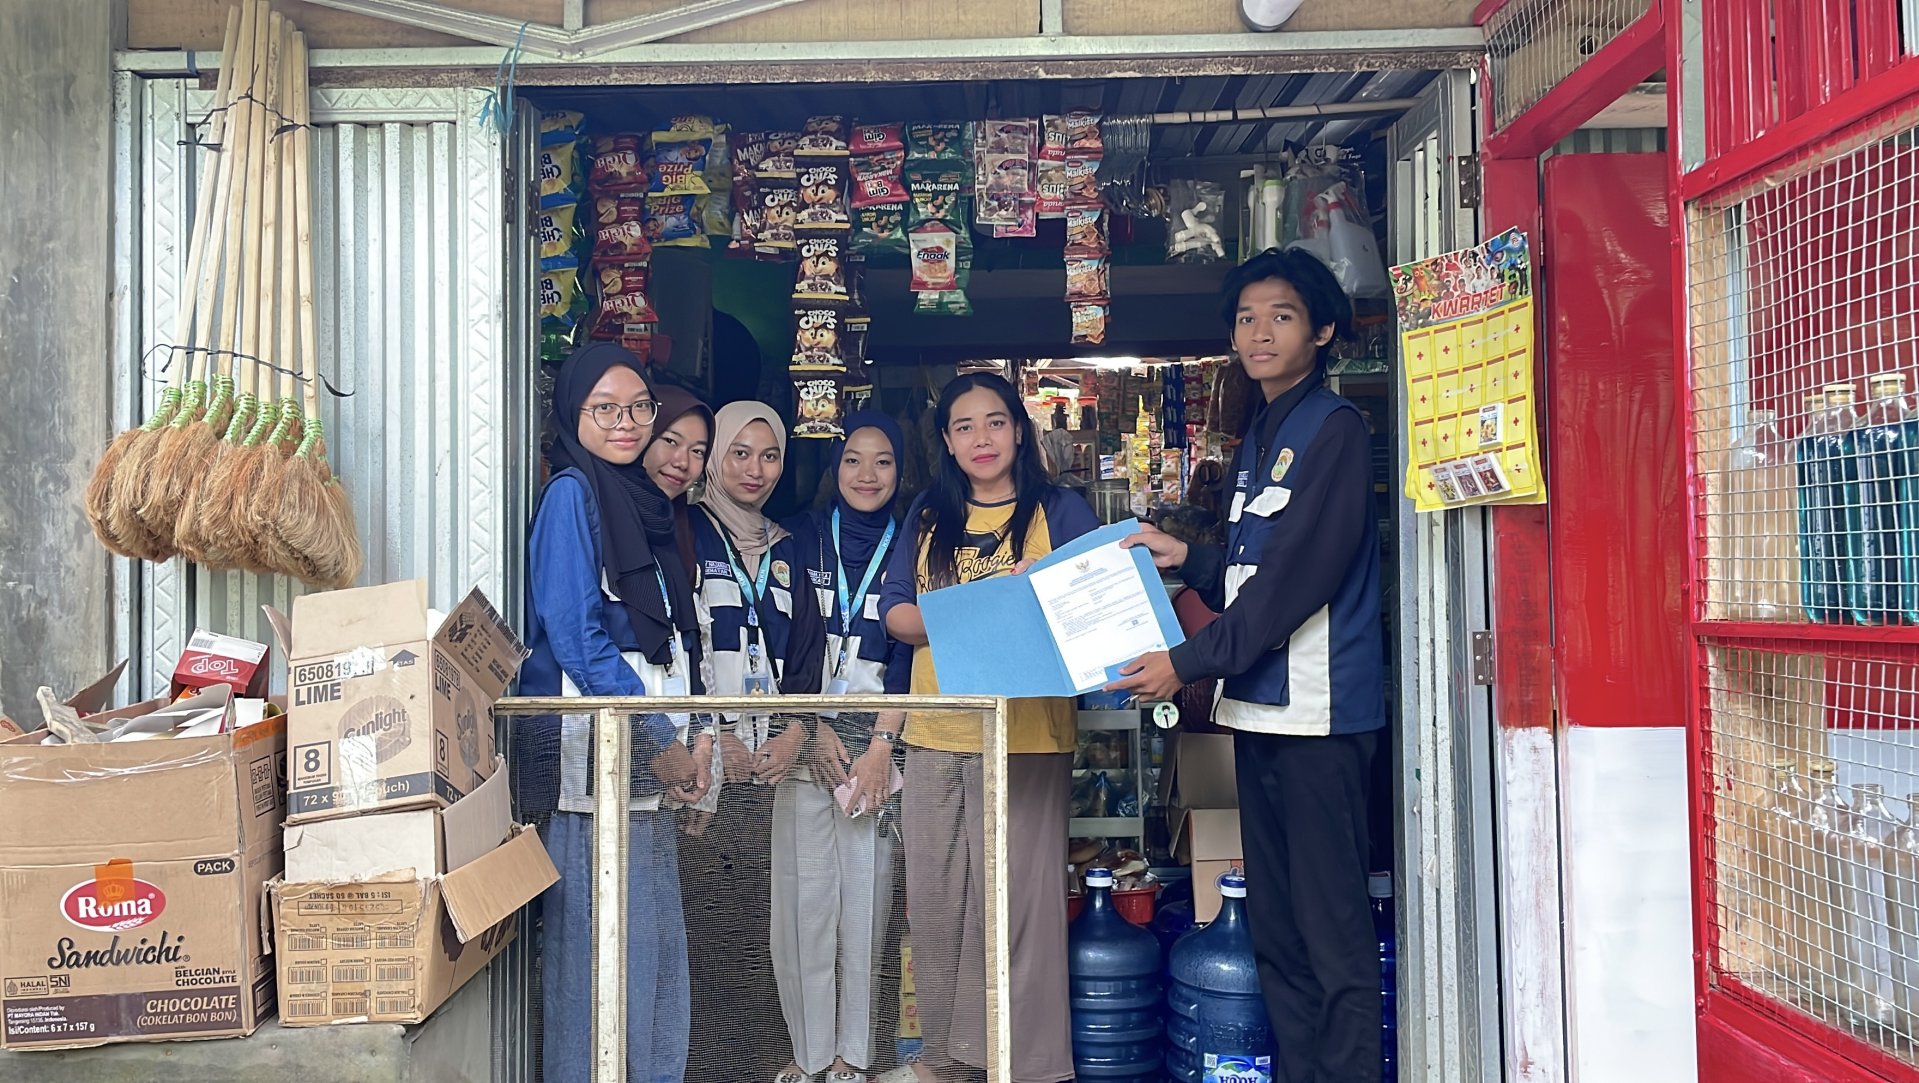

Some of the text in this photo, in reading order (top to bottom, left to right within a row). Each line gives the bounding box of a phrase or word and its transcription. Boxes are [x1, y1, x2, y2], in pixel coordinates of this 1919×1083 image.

[658, 164, 693, 175] Prize
[808, 166, 837, 174] CHOCO
[1066, 166, 1094, 179] Malkist
[800, 172, 839, 187] CHIPS
[868, 187, 889, 197] Gim
[911, 182, 960, 192] MAKARENA
[650, 204, 684, 216] Prize
[1067, 215, 1094, 228] Malkist
[598, 220, 642, 244] Qtela
[801, 244, 839, 258] CHIPS
[916, 250, 951, 260] Enaak
[602, 292, 648, 314] Qtela
[1432, 283, 1506, 320] KWARTET
[798, 315, 838, 330] CHIPS
[806, 380, 836, 388] CHOCO
[960, 551, 1016, 577] Boogie
[295, 682, 342, 706] LIME
[435, 672, 451, 702] LIME
[439, 738, 446, 762] 8
[304, 748, 320, 772] 8
[304, 794, 318, 806] 72
[322, 794, 329, 804] x
[196, 860, 231, 874] PACK
[308, 892, 334, 900] SACHET
[78, 896, 152, 918] Roma
[48, 930, 185, 970] Sandwichi
[175, 968, 220, 978] BELGIAN
[176, 974, 238, 986] CHOCOLATE
[146, 995, 237, 1013] CHOCOLATE
[137, 1009, 238, 1028] (COKELAT BON BON)
[50, 1024, 56, 1032] 6
[63, 1023, 68, 1031] 7
[75, 1022, 88, 1031] 157
[89, 1023, 95, 1032] g
